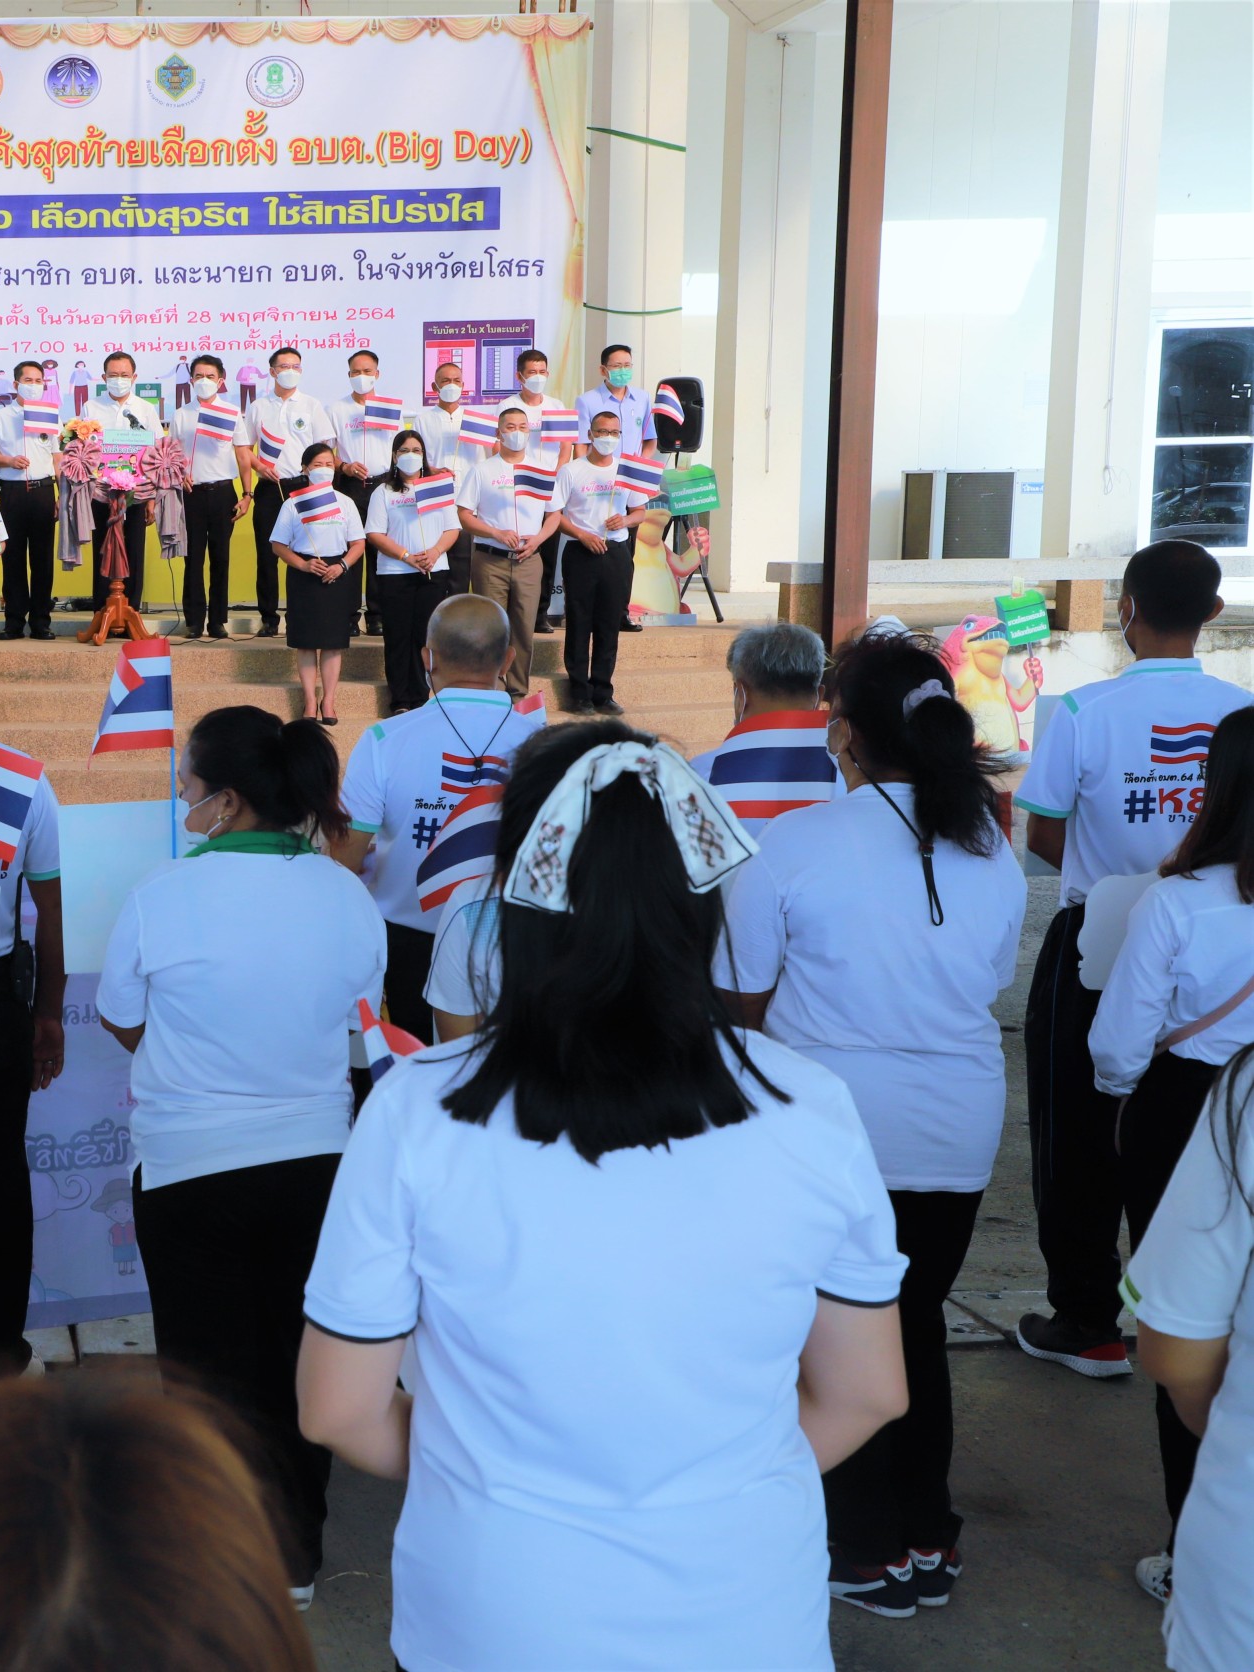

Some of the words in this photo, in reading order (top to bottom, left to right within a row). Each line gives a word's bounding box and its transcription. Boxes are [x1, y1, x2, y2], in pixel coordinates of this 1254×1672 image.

[454, 128, 532, 168] Day)
[31, 195, 249, 235] เลือกตั้งสุจริต
[262, 191, 484, 226] ใช้สิทธิโปร่งใส
[81, 266, 143, 285] อบต.
[155, 264, 272, 285] และนายก
[283, 263, 344, 283] อบต.
[353, 246, 545, 281] ในจังหวัดยโสธร
[36, 304, 178, 326] ในวันอาทิตย์ที่
[187, 310, 212, 324] 28
[219, 307, 338, 327] พฤศจิกายน
[346, 307, 396, 321] 2564
[74, 342, 94, 353] น.
[103, 342, 124, 354] ณ
[131, 328, 371, 352] หน่วยเลือกตั้งที่ท่านมีชื่อ
[466, 324, 478, 334] ใบ
[917, 1559, 935, 1567] PUMA
